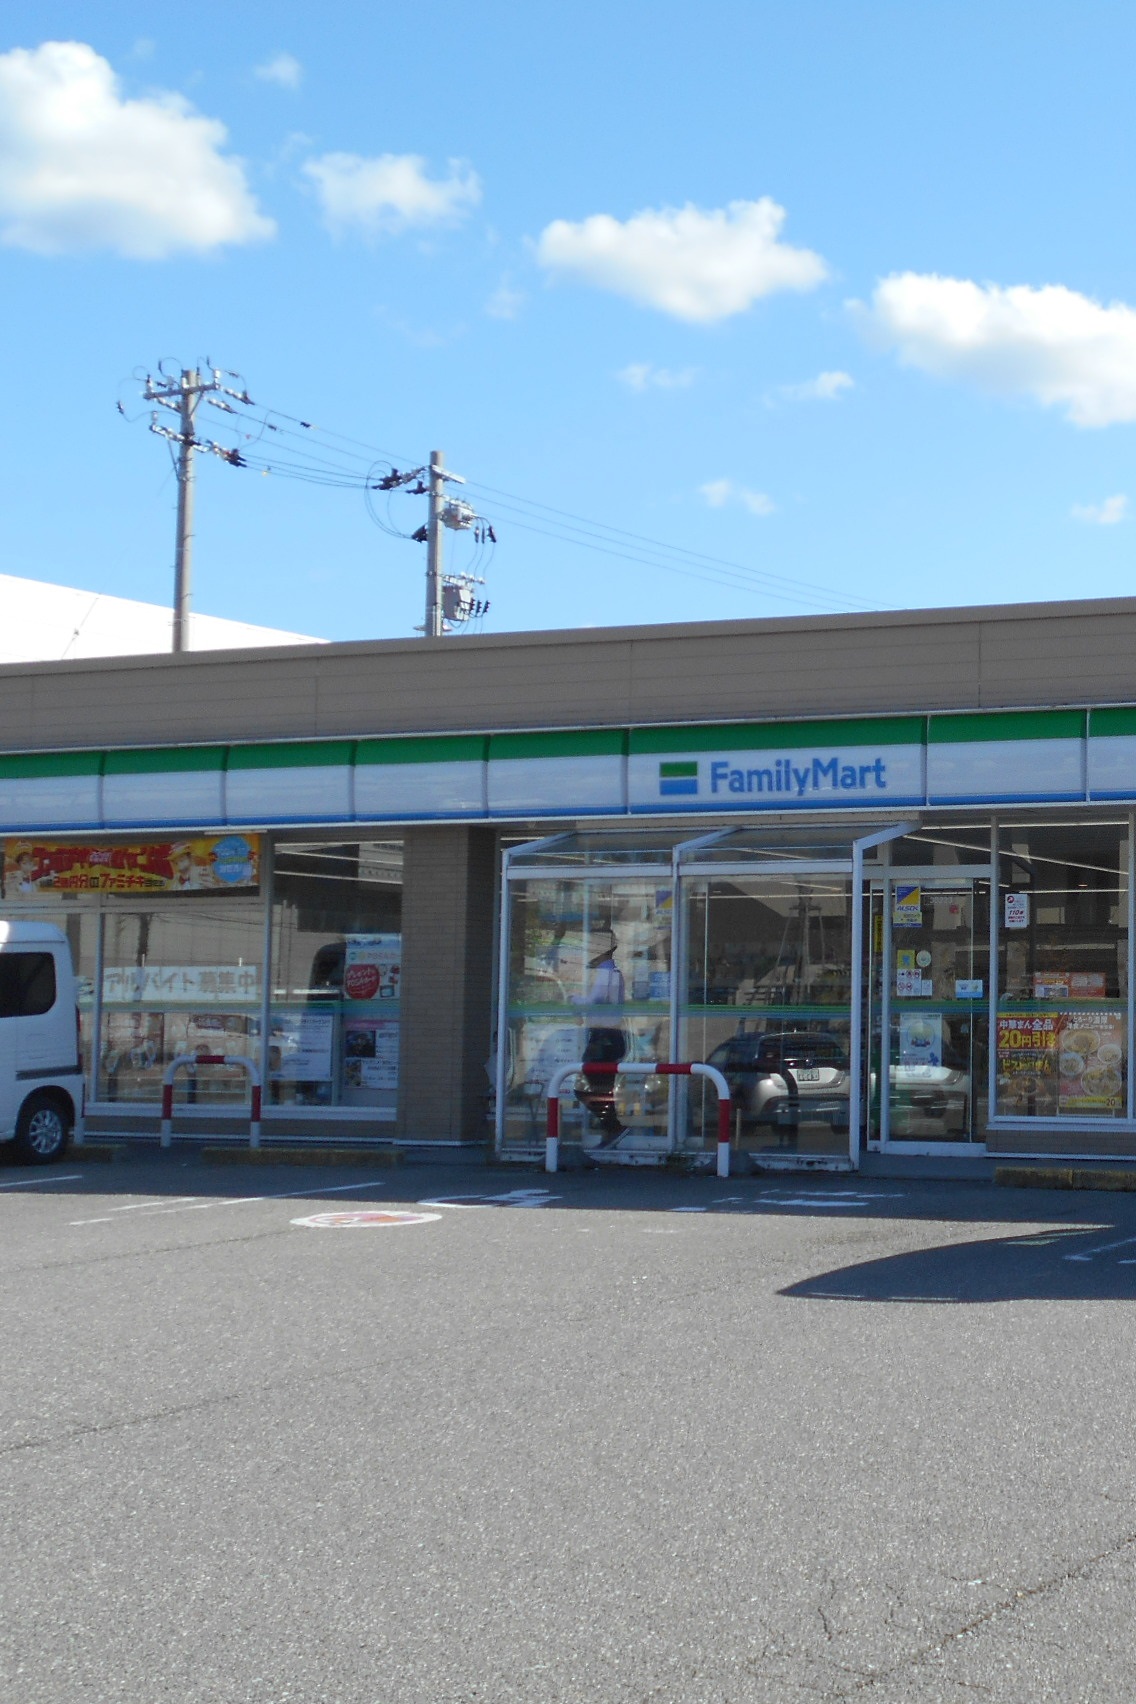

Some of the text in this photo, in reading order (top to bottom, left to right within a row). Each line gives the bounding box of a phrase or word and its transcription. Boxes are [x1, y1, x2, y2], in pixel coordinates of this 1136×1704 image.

[711, 758, 886, 796] FamilyMart
[105, 971, 255, 994] アルバイト募集中
[999, 1018, 1053, 1031] 中華まん全品
[999, 1029, 1056, 1048] 20円引き
